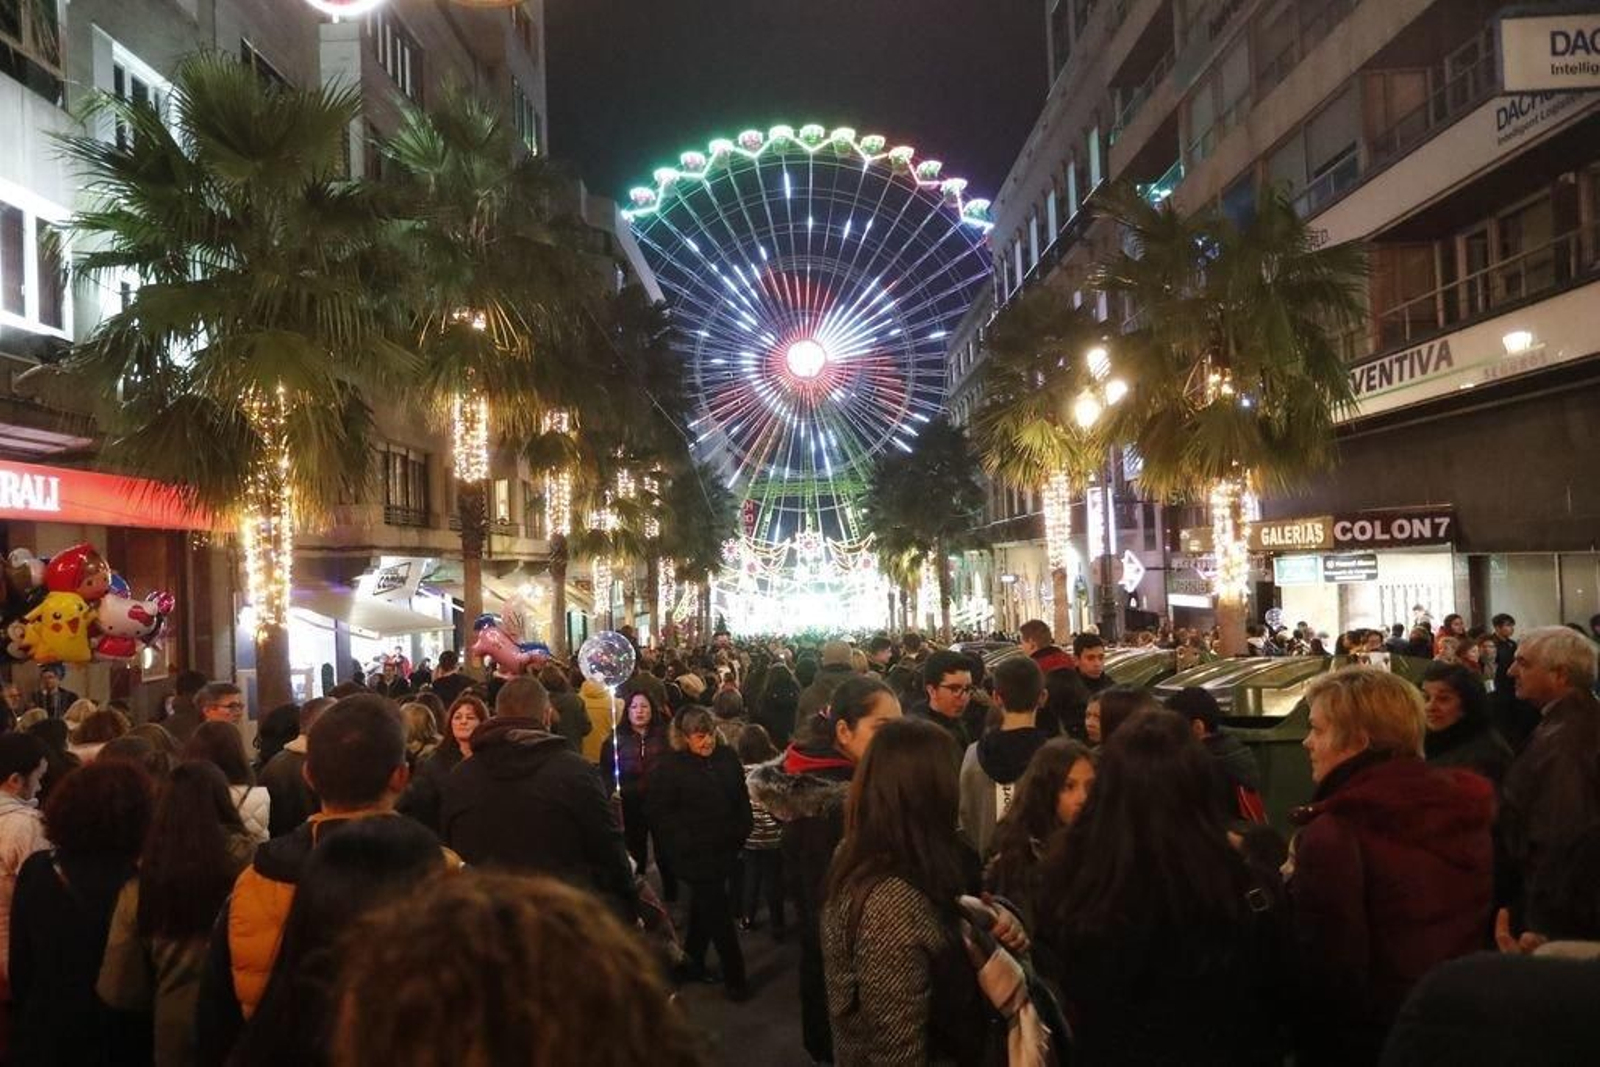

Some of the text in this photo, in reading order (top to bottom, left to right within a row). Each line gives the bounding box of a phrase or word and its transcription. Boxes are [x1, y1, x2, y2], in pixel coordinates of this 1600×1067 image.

[1350, 339, 1454, 396] VENTIVA
[1260, 517, 1450, 546] GALERIAS COLON 7
